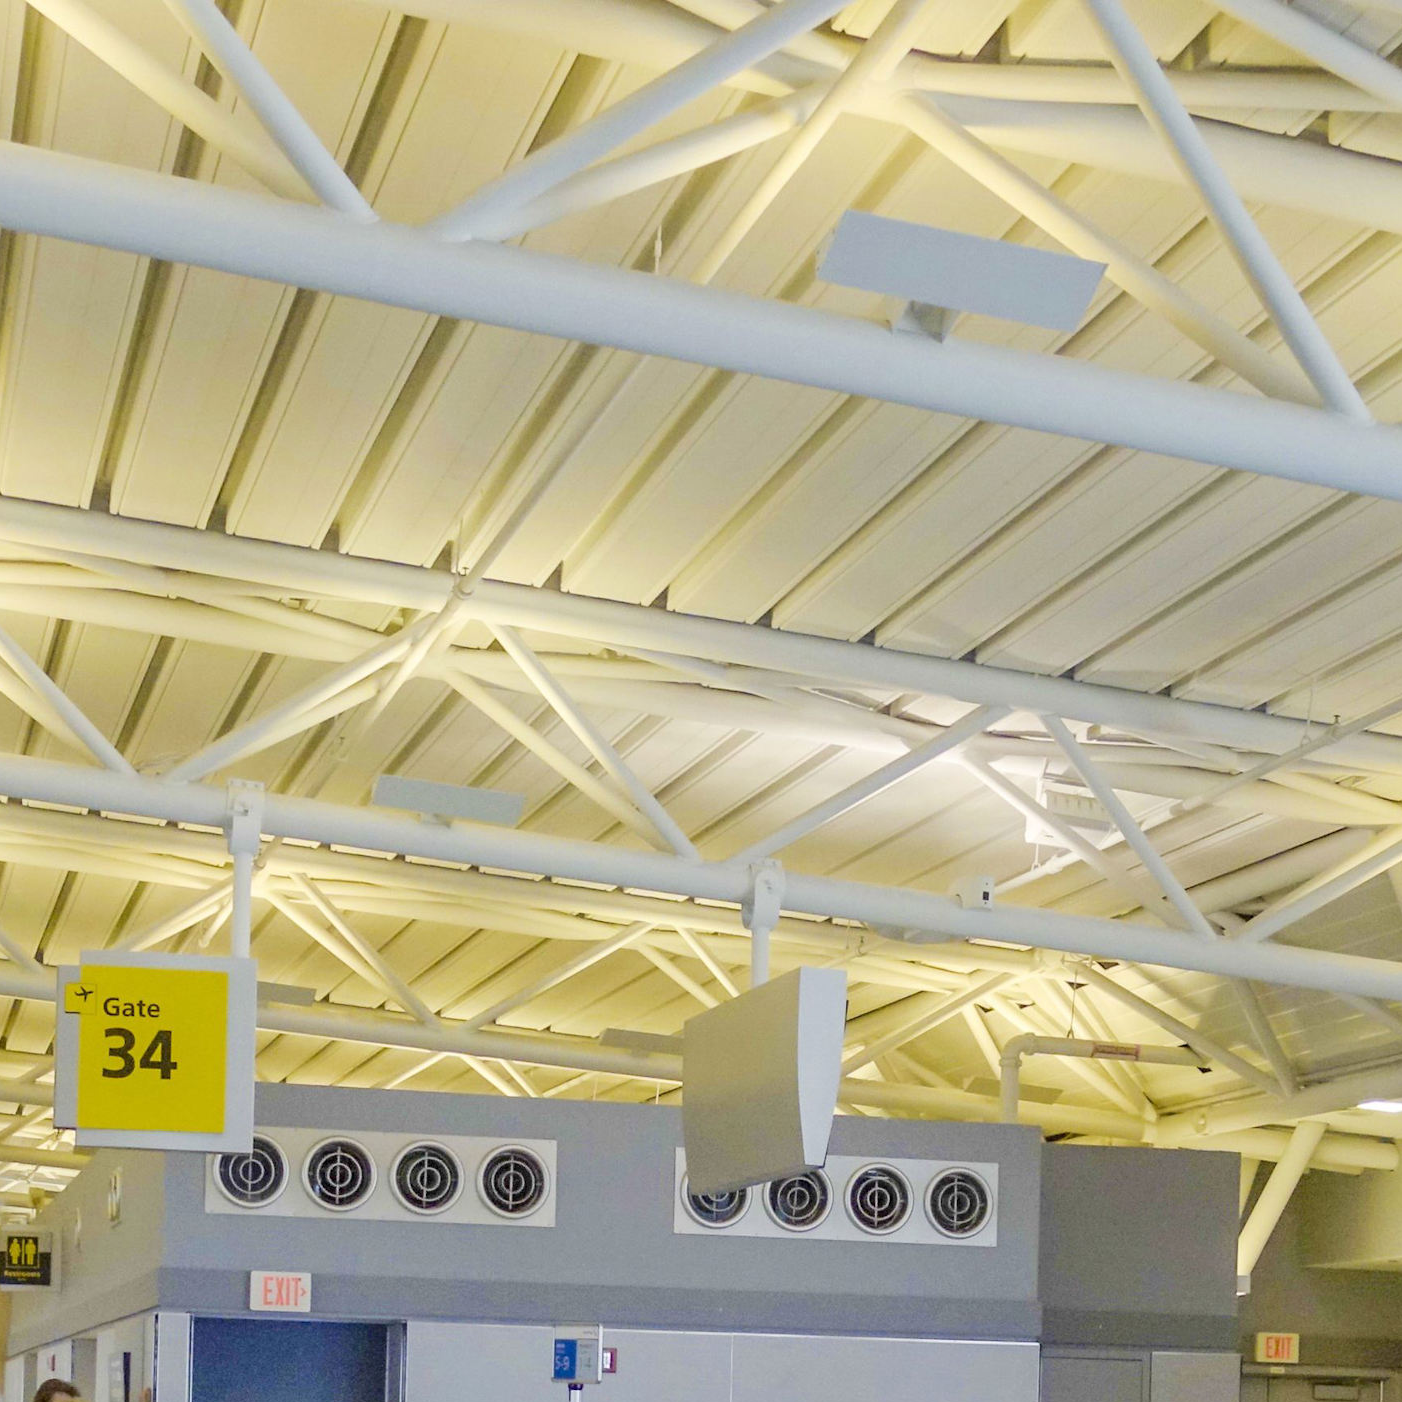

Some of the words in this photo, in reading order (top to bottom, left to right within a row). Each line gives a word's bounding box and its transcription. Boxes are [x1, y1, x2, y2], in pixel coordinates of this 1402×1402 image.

[103, 998, 160, 1017] Gate
[102, 1027, 177, 1079] 34
[262, 1276, 302, 1306] EXIT
[1266, 1336, 1292, 1358] EXIT
